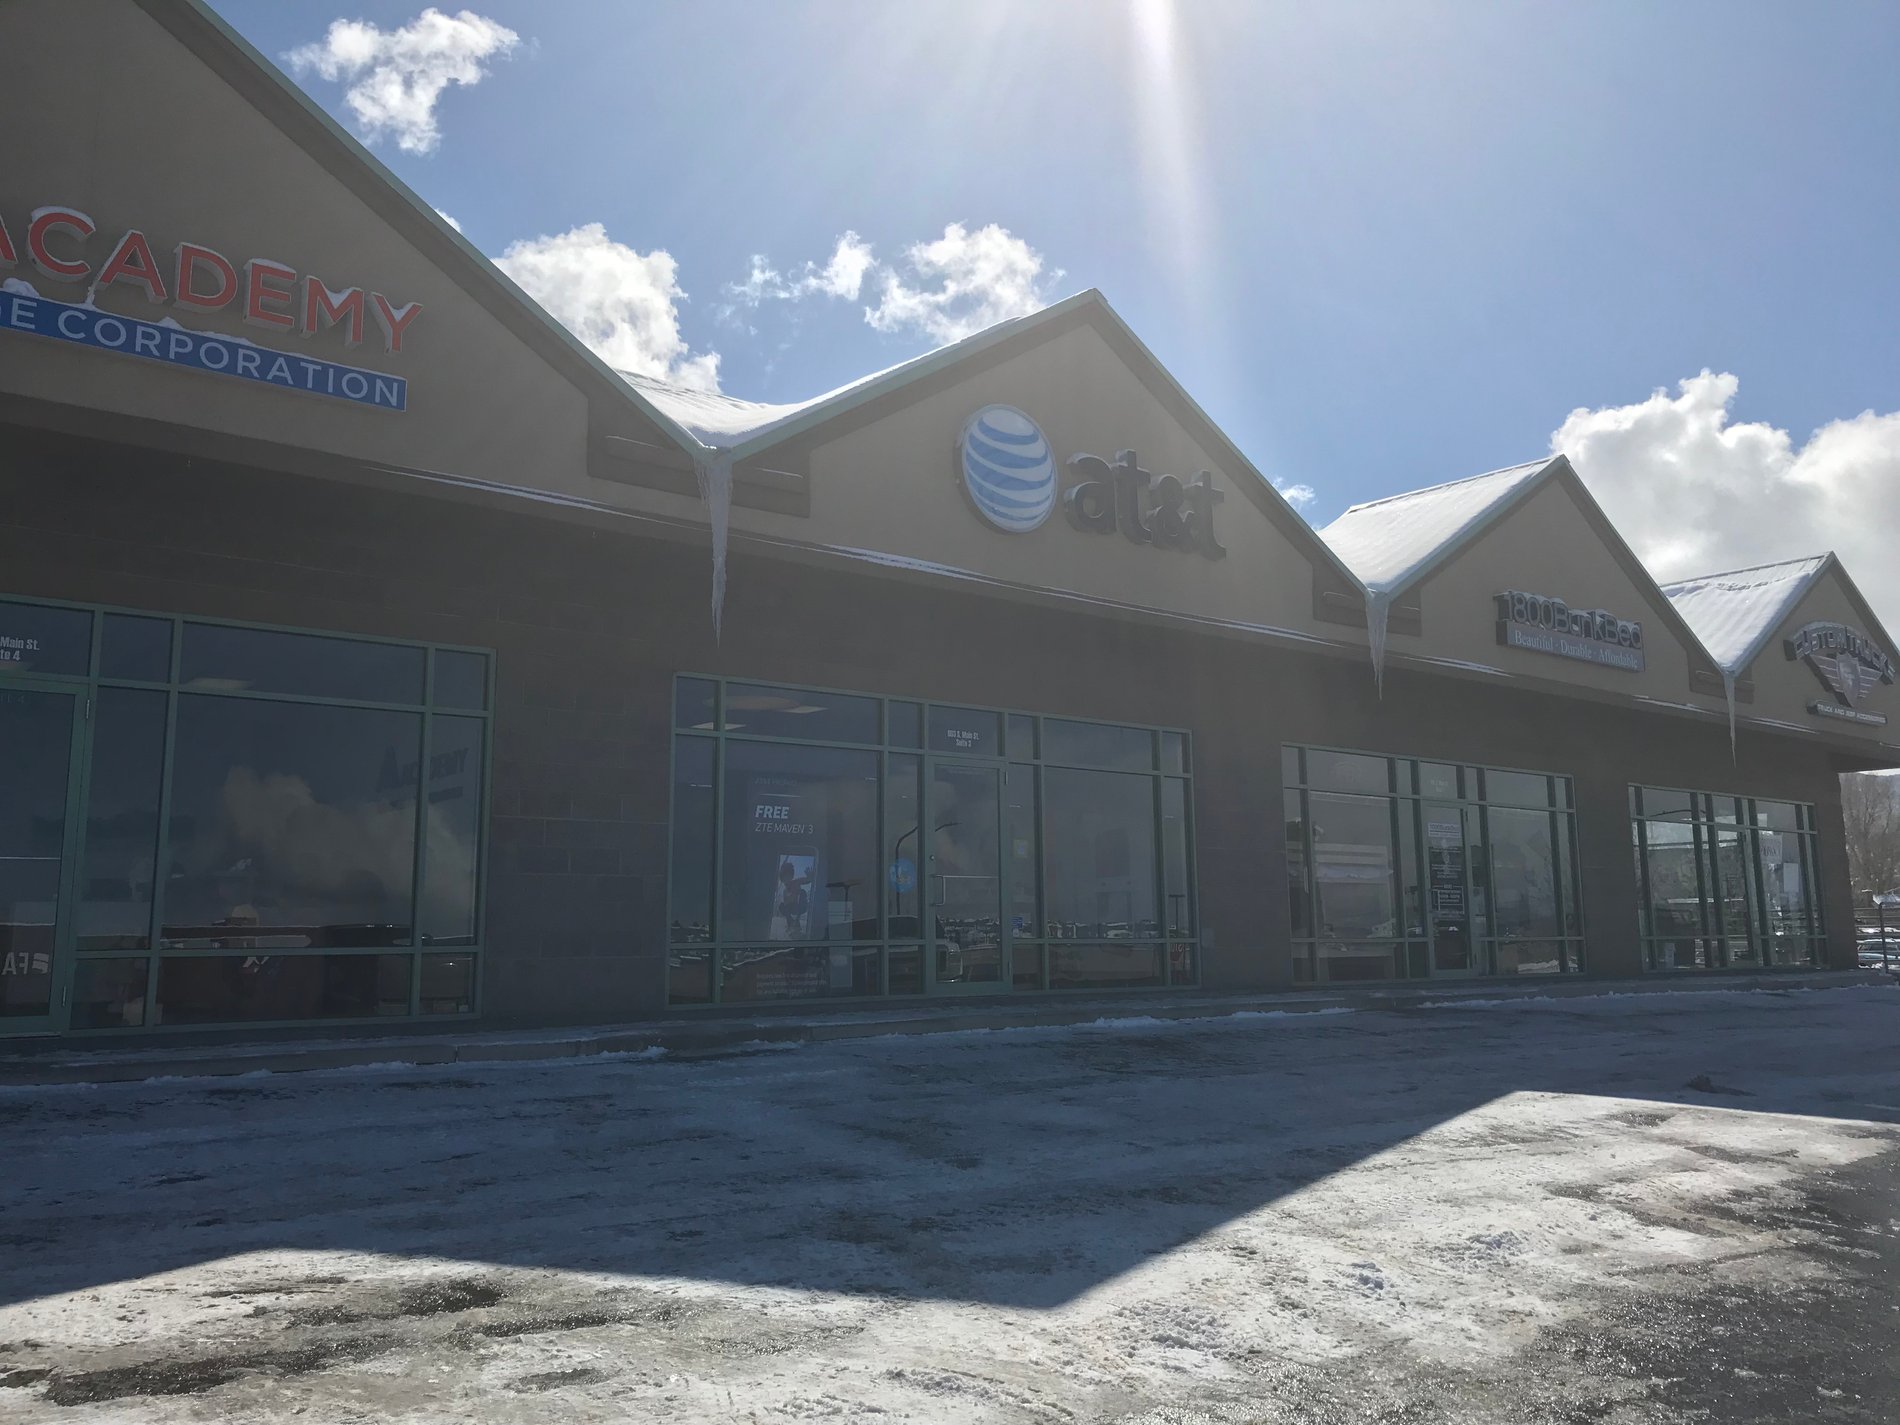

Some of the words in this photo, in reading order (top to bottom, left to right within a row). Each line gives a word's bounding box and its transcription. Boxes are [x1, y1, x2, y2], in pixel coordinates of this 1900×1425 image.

[0, 206, 423, 354] CADEMY
[0, 297, 38, 330] E
[58, 310, 400, 406] CORPORATION
[0, 636, 24, 649] Main
[1514, 630, 1553, 650] Beautiful
[1560, 640, 1592, 659] Durable
[1599, 650, 1638, 669] Affordable
[12, 650, 21, 661] 4
[755, 805, 790, 819] FREE
[755, 822, 773, 833] ZTE
[773, 823, 805, 834] MAVEN
[808, 824, 815, 835] 3
